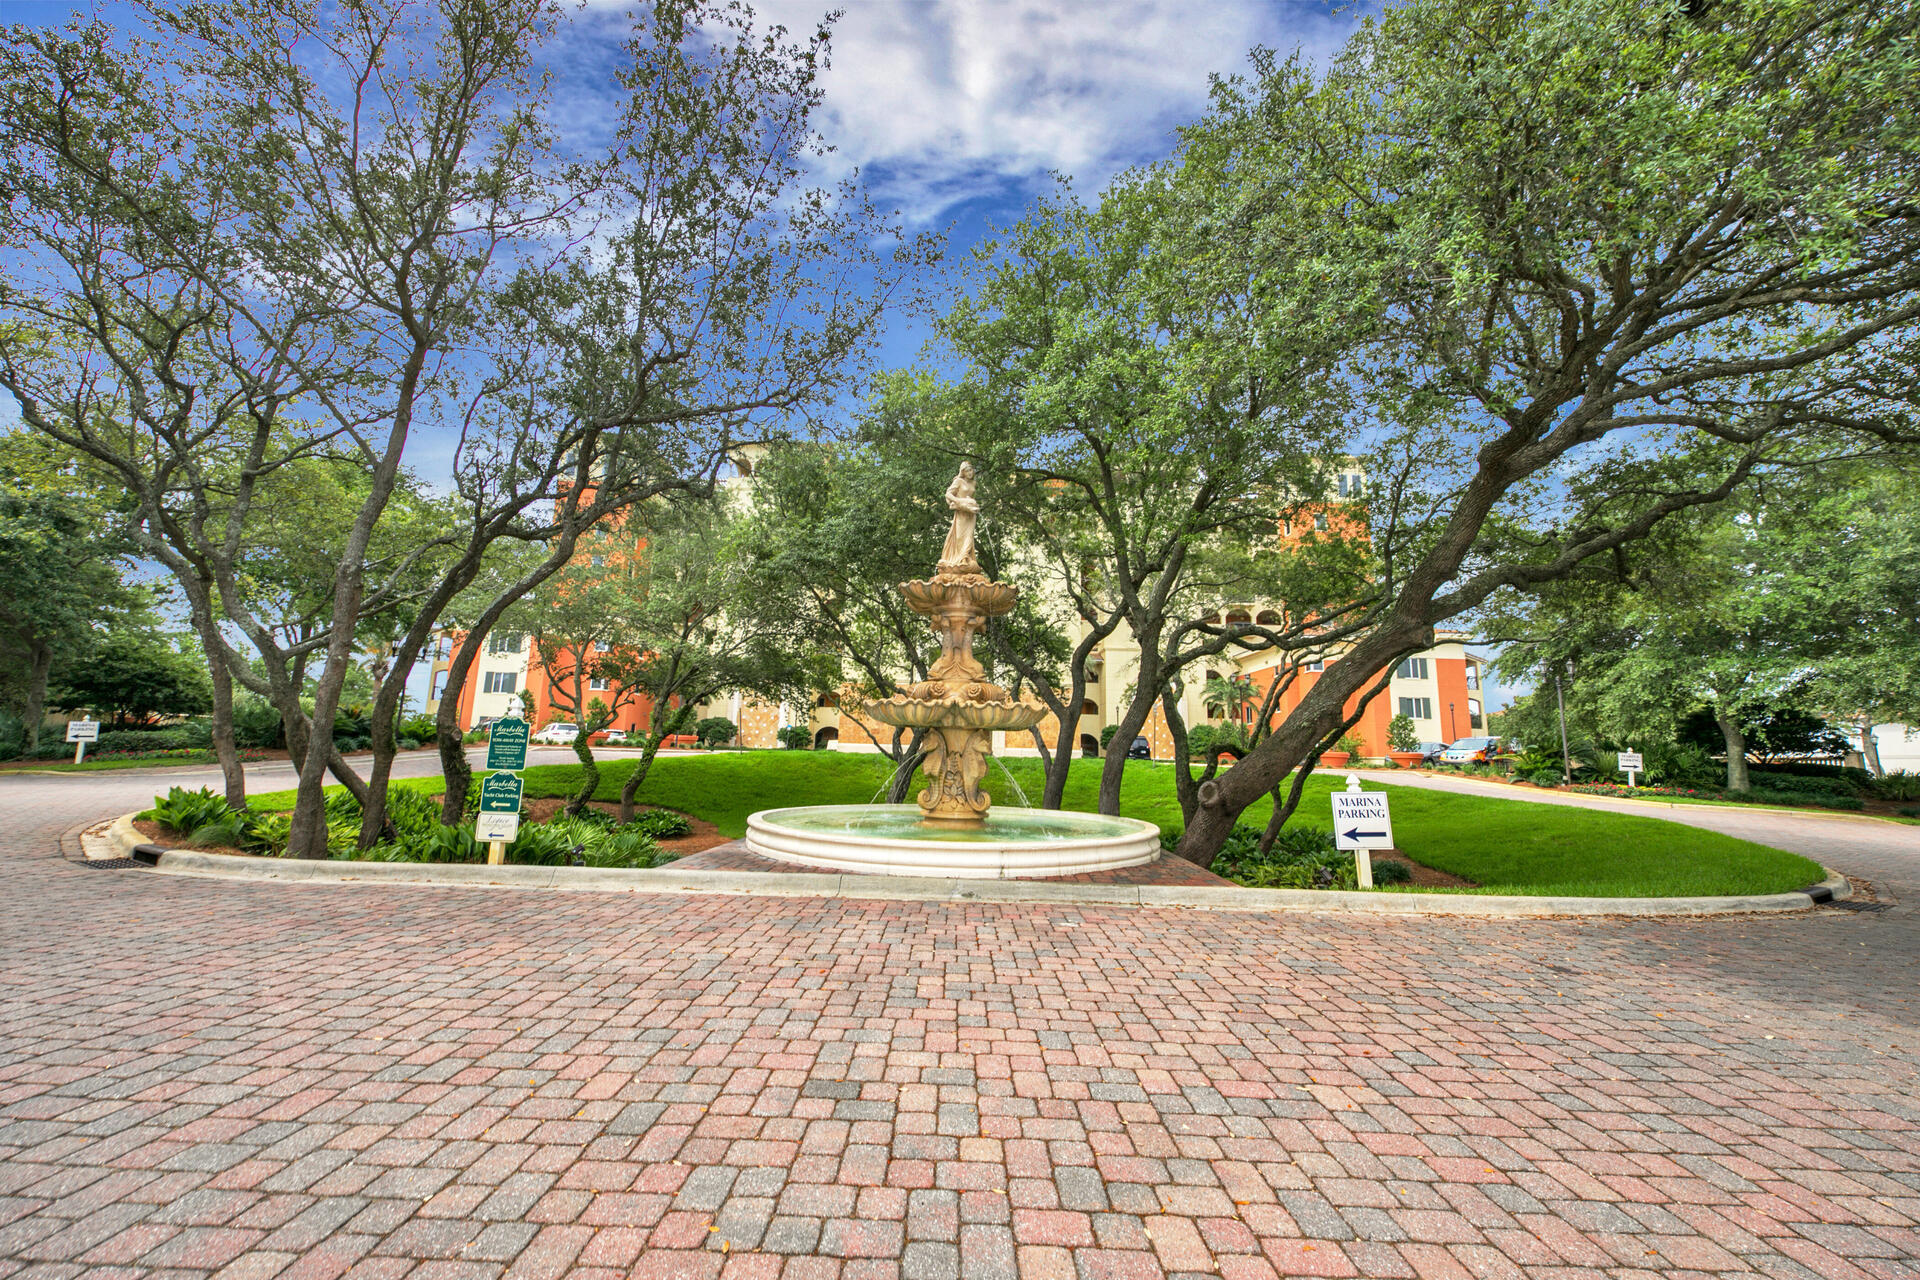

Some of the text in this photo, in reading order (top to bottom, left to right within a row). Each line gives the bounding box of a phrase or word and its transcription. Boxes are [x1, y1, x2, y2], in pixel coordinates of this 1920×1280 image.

[494, 725, 525, 733] Marbella
[486, 779, 518, 788] Marbella
[1339, 797, 1382, 806] MARINA
[1338, 809, 1385, 819] PARKING
